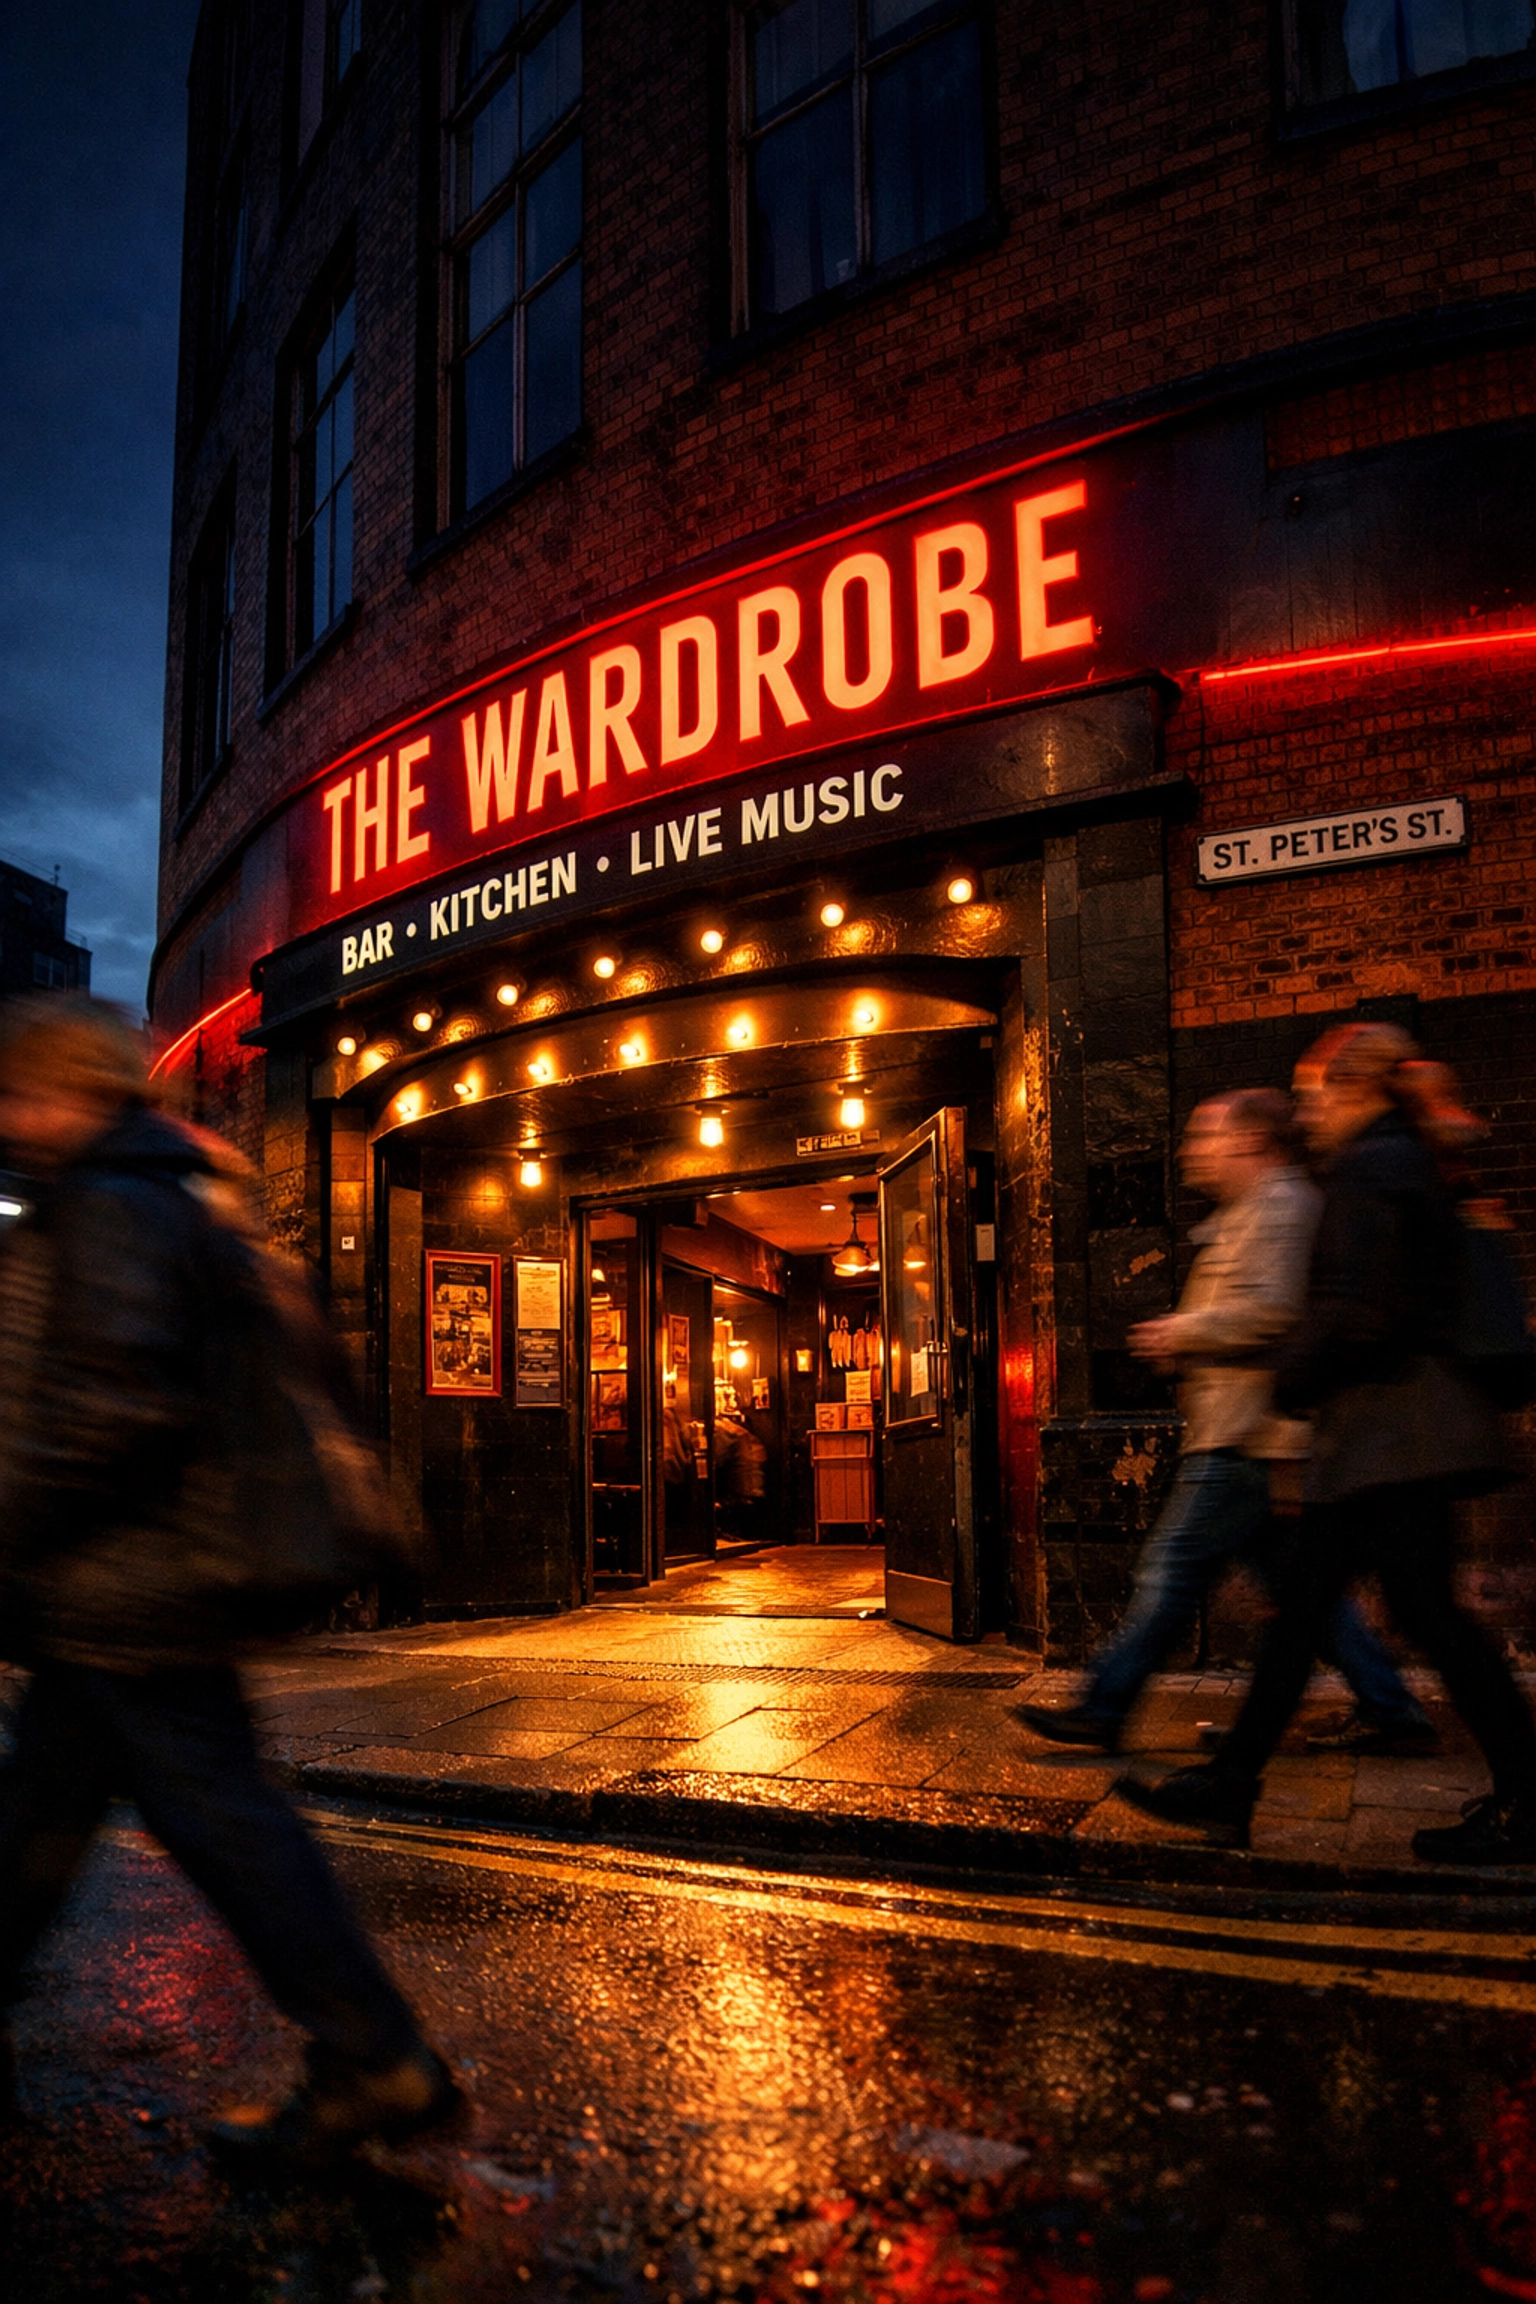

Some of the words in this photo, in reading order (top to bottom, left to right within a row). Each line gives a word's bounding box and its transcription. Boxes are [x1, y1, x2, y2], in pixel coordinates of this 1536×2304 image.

[323, 734, 430, 894] THE
[461, 479, 1095, 833] WARDROBE
[342, 921, 394, 975] BAR
[430, 851, 577, 941] KITCHEN
[630, 807, 723, 876] LIVE
[741, 763, 904, 845] MUSIC
[1213, 840, 1259, 870] ST.
[1270, 816, 1399, 861] PETER'S
[1407, 809, 1453, 840] ST.
